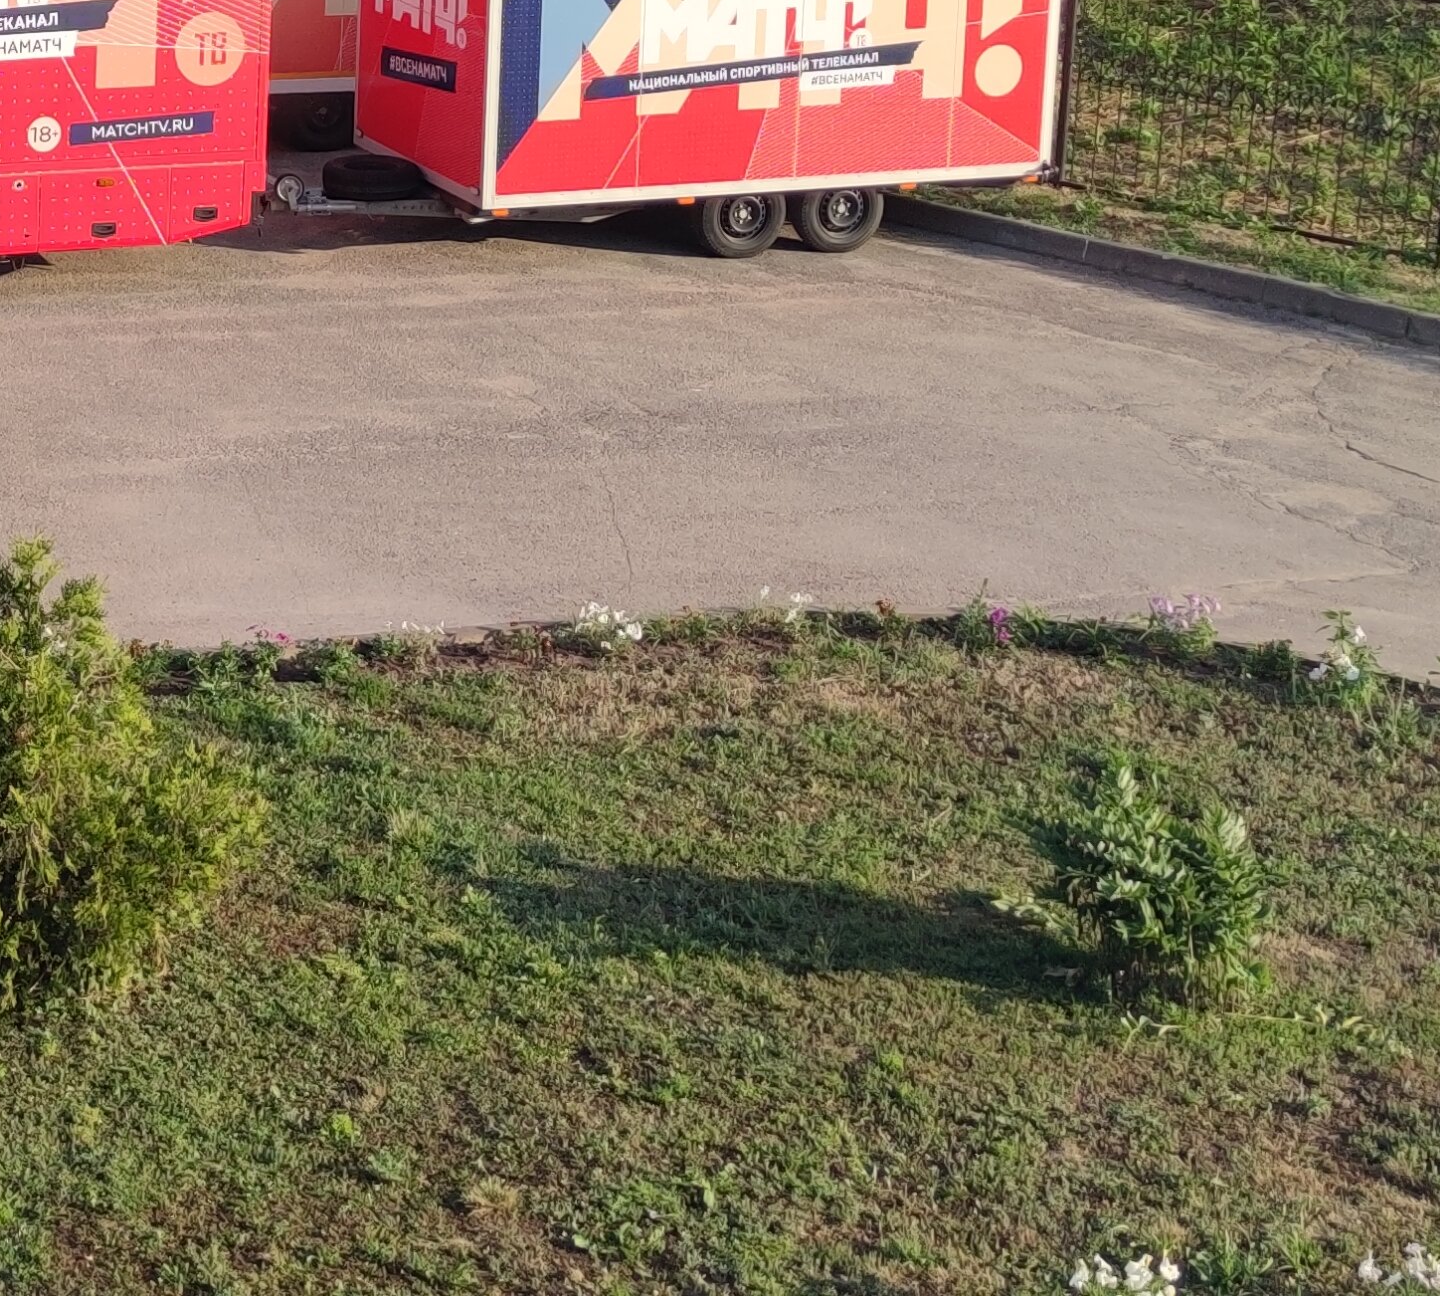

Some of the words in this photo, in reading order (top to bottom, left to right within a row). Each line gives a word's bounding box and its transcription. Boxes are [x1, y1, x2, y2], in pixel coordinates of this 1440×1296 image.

[389, 55, 448, 83] #ВСЕНАМАТЧ
[628, 67, 728, 91] НАЦИОНАЛЬНЫЙ
[729, 58, 810, 80] СПОРТИВНЫЙ
[812, 52, 880, 70] ТЕЛЕКАНАЛ
[811, 71, 883, 86] #ВСЕНАМАТЧ
[30, 126, 59, 143] 18+
[91, 117, 194, 140] MATCHTV.RU
